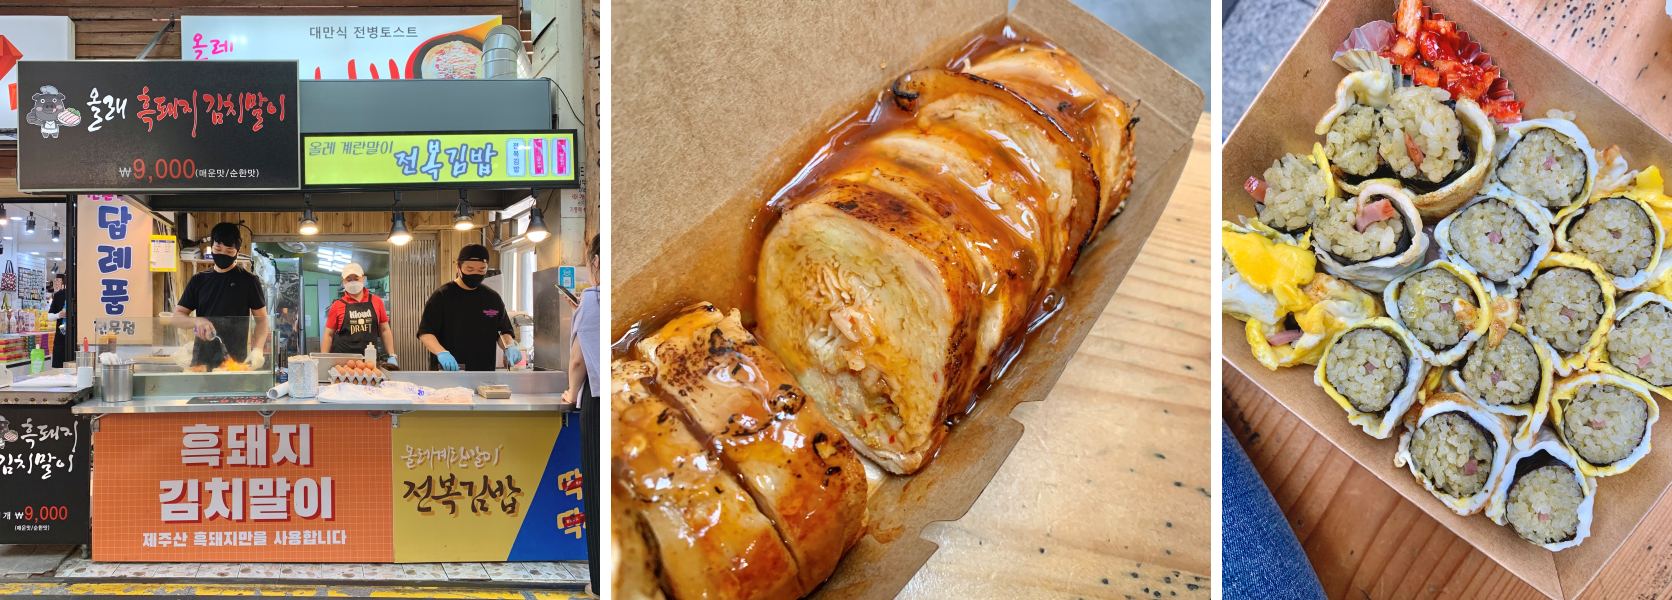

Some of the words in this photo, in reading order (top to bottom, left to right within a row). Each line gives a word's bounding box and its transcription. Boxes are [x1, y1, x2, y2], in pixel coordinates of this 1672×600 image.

[309, 26, 347, 39] 대만식
[353, 26, 419, 39] 전병토스트
[136, 86, 198, 138] 흑돼지
[203, 92, 285, 132] 김치말이
[341, 141, 393, 155] 계란말이
[394, 140, 498, 180] 전복김밥
[97, 205, 132, 315] 답례품
[350, 324, 372, 335] DRAFT
[20, 417, 78, 453] 흑돼지
[181, 423, 315, 468] 흑돼지
[159, 476, 335, 523] 김치말이
[402, 472, 522, 516] 전복김밥
[142, 532, 188, 548] 제주산
[193, 531, 268, 546] 흑돼지만을
[273, 530, 347, 546] 사용합니다
